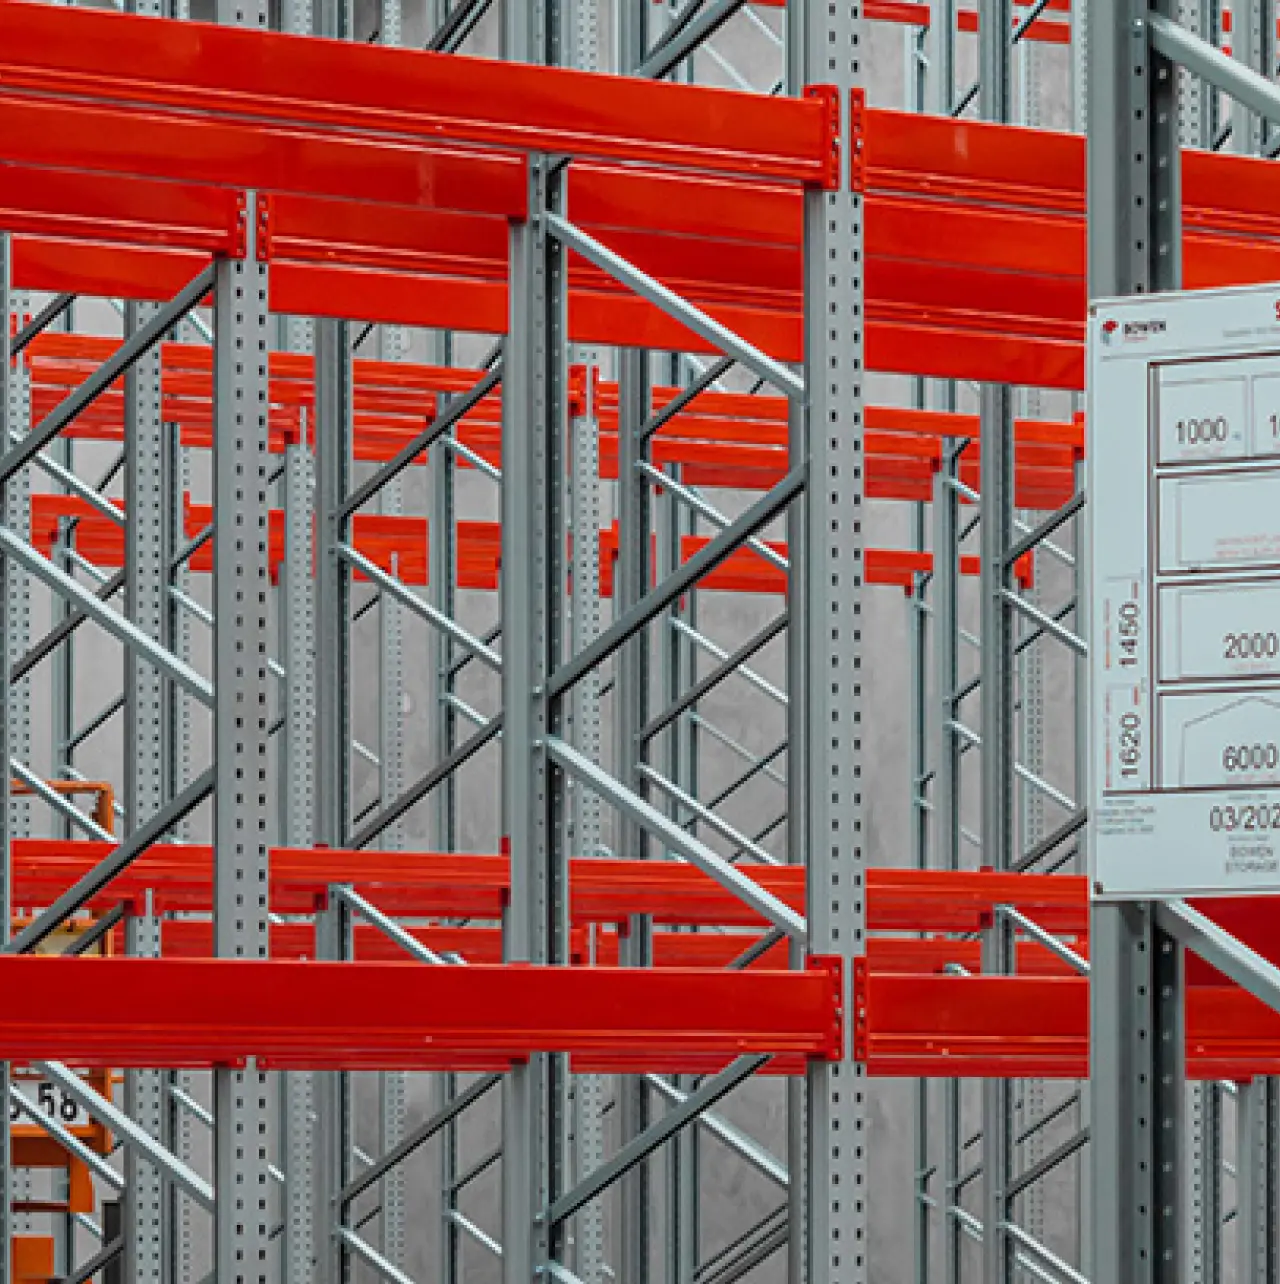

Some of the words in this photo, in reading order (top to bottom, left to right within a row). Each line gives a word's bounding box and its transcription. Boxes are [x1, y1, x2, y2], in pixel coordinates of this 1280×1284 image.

[1176, 416, 1227, 444] 1000
[1118, 602, 1140, 666] 1450
[1223, 632, 1279, 658] 2000
[1118, 712, 1141, 777] 1620
[1223, 743, 1279, 771] 6000
